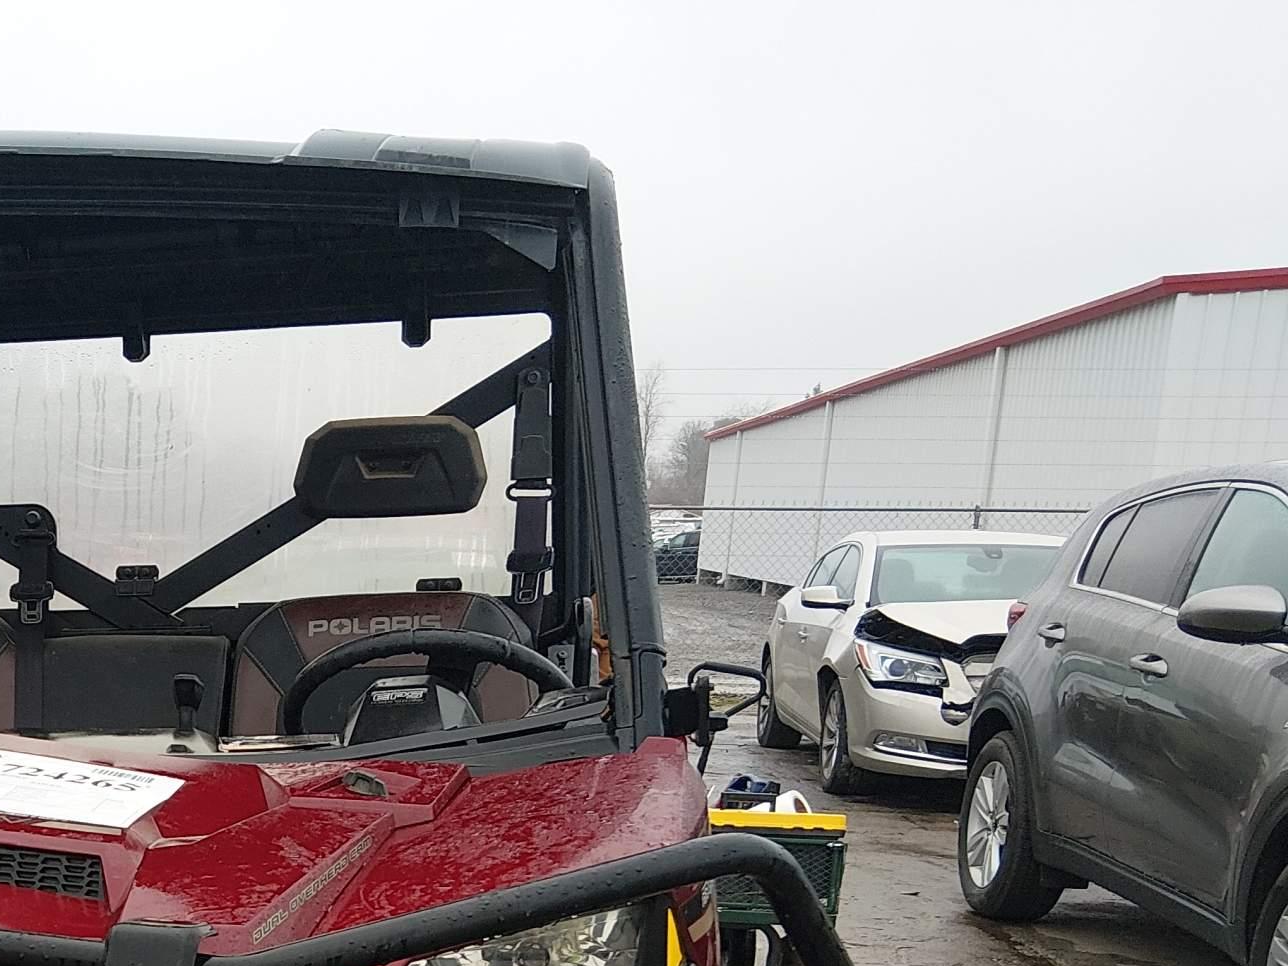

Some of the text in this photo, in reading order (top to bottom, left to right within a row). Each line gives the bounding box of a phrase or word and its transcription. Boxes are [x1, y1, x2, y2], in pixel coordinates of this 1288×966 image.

[307, 614, 442, 638] POLARIS
[252, 834, 374, 945] DUAL OVERHEAD CAM
